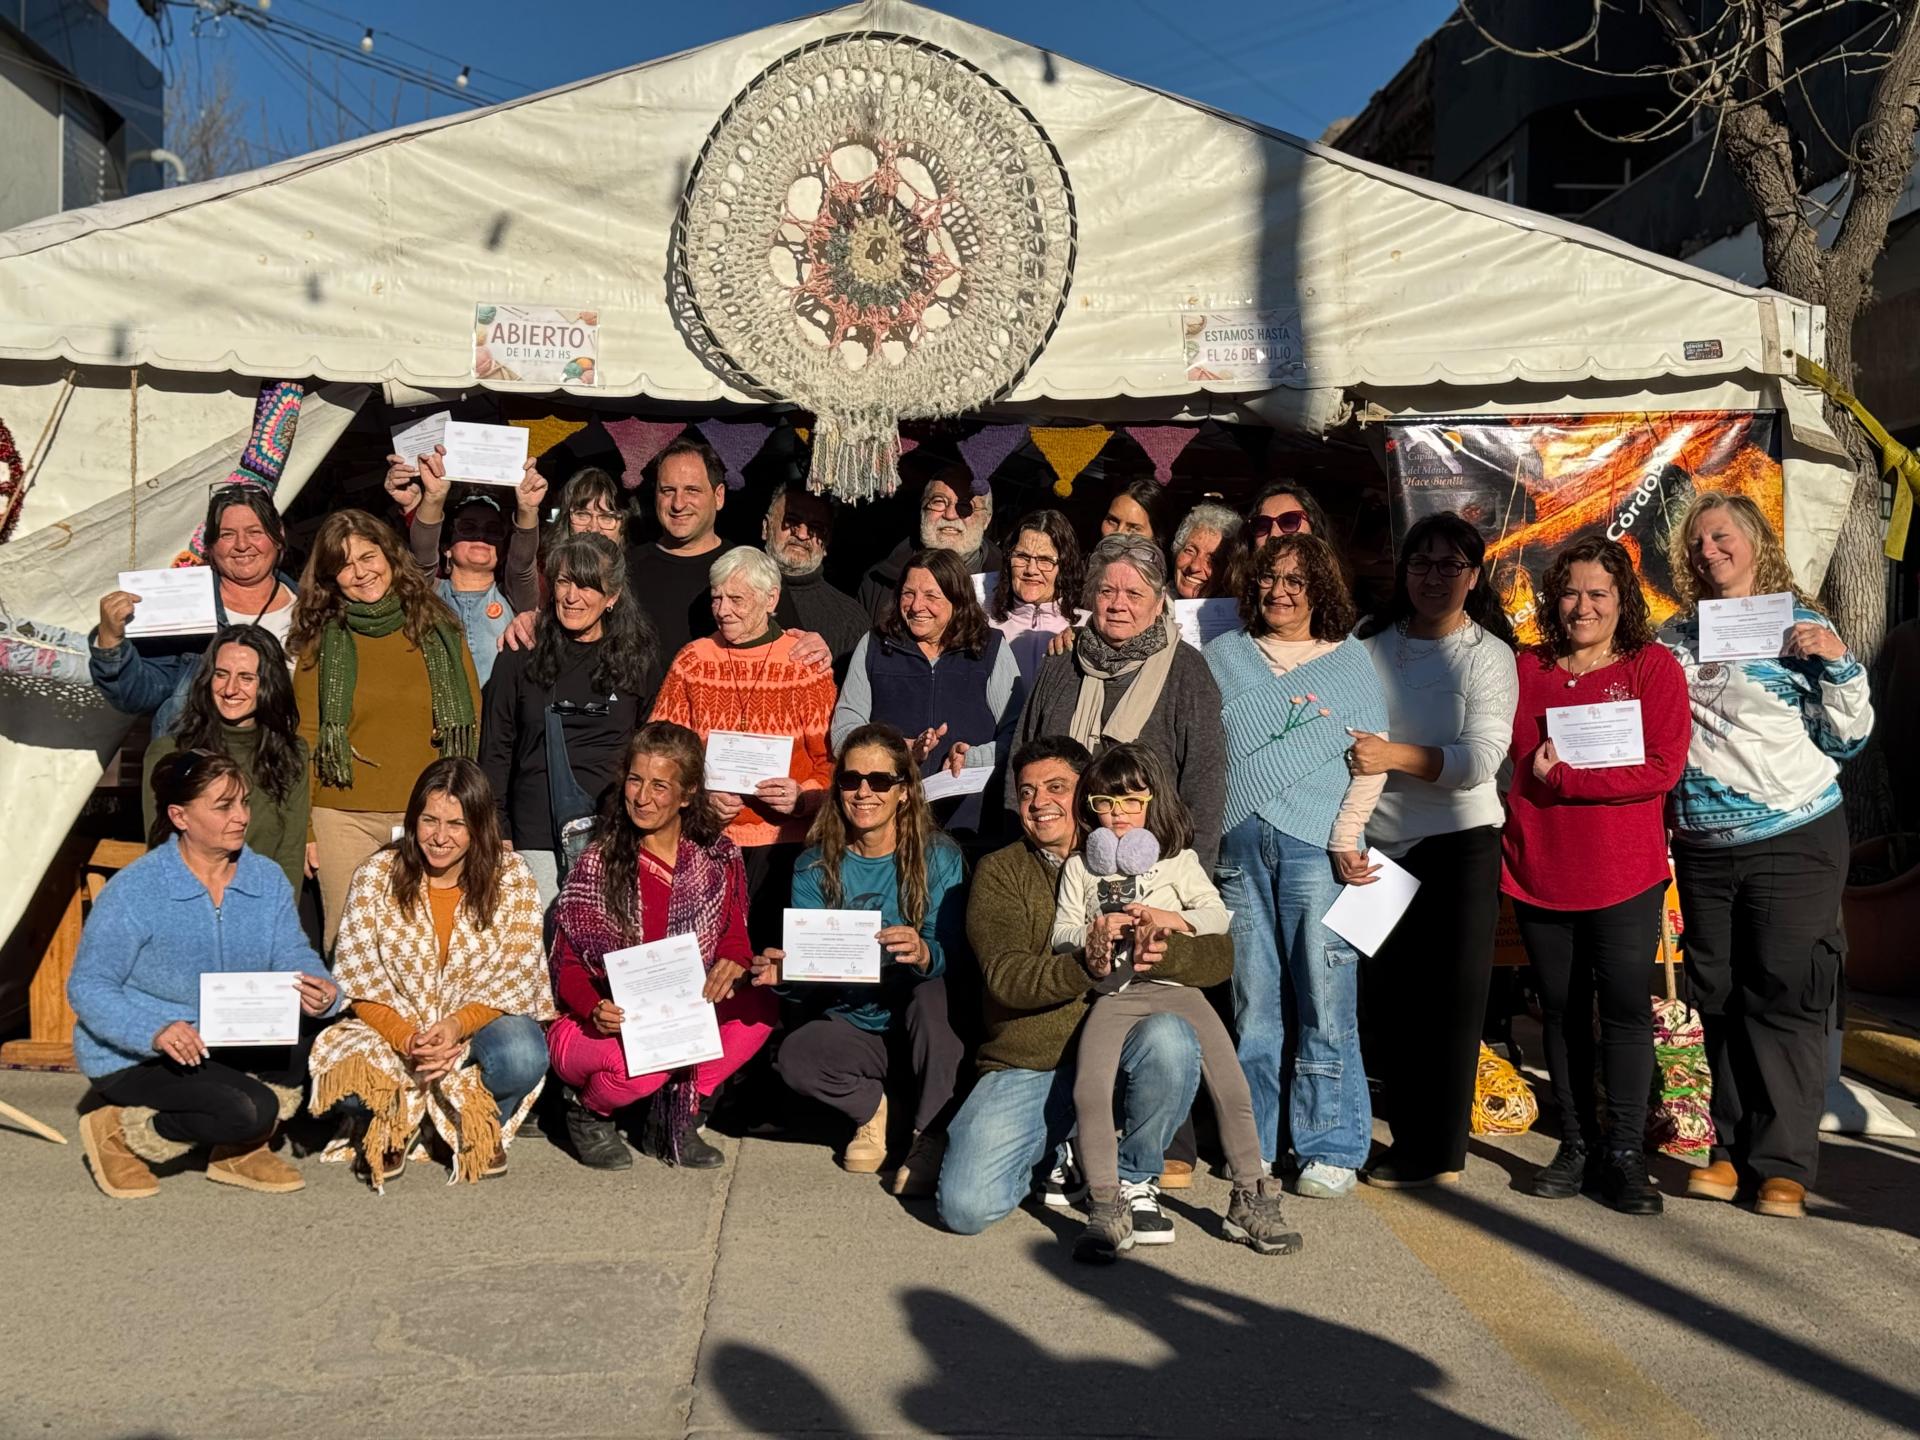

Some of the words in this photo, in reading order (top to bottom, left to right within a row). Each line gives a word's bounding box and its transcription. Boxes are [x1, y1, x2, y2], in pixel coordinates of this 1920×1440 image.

[490, 322, 585, 349] ABIERTO
[1205, 328, 1254, 342] ESTAMOS
[1258, 327, 1290, 340] HASTA
[506, 347, 519, 357] DE
[523, 348, 531, 358] 11
[534, 349, 541, 358] A
[545, 349, 555, 359] 21
[558, 350, 571, 360] HS
[1207, 348, 1221, 362] EL
[1224, 347, 1238, 361] 26
[1242, 347, 1256, 361] DE
[1422, 465, 1449, 475] Monte
